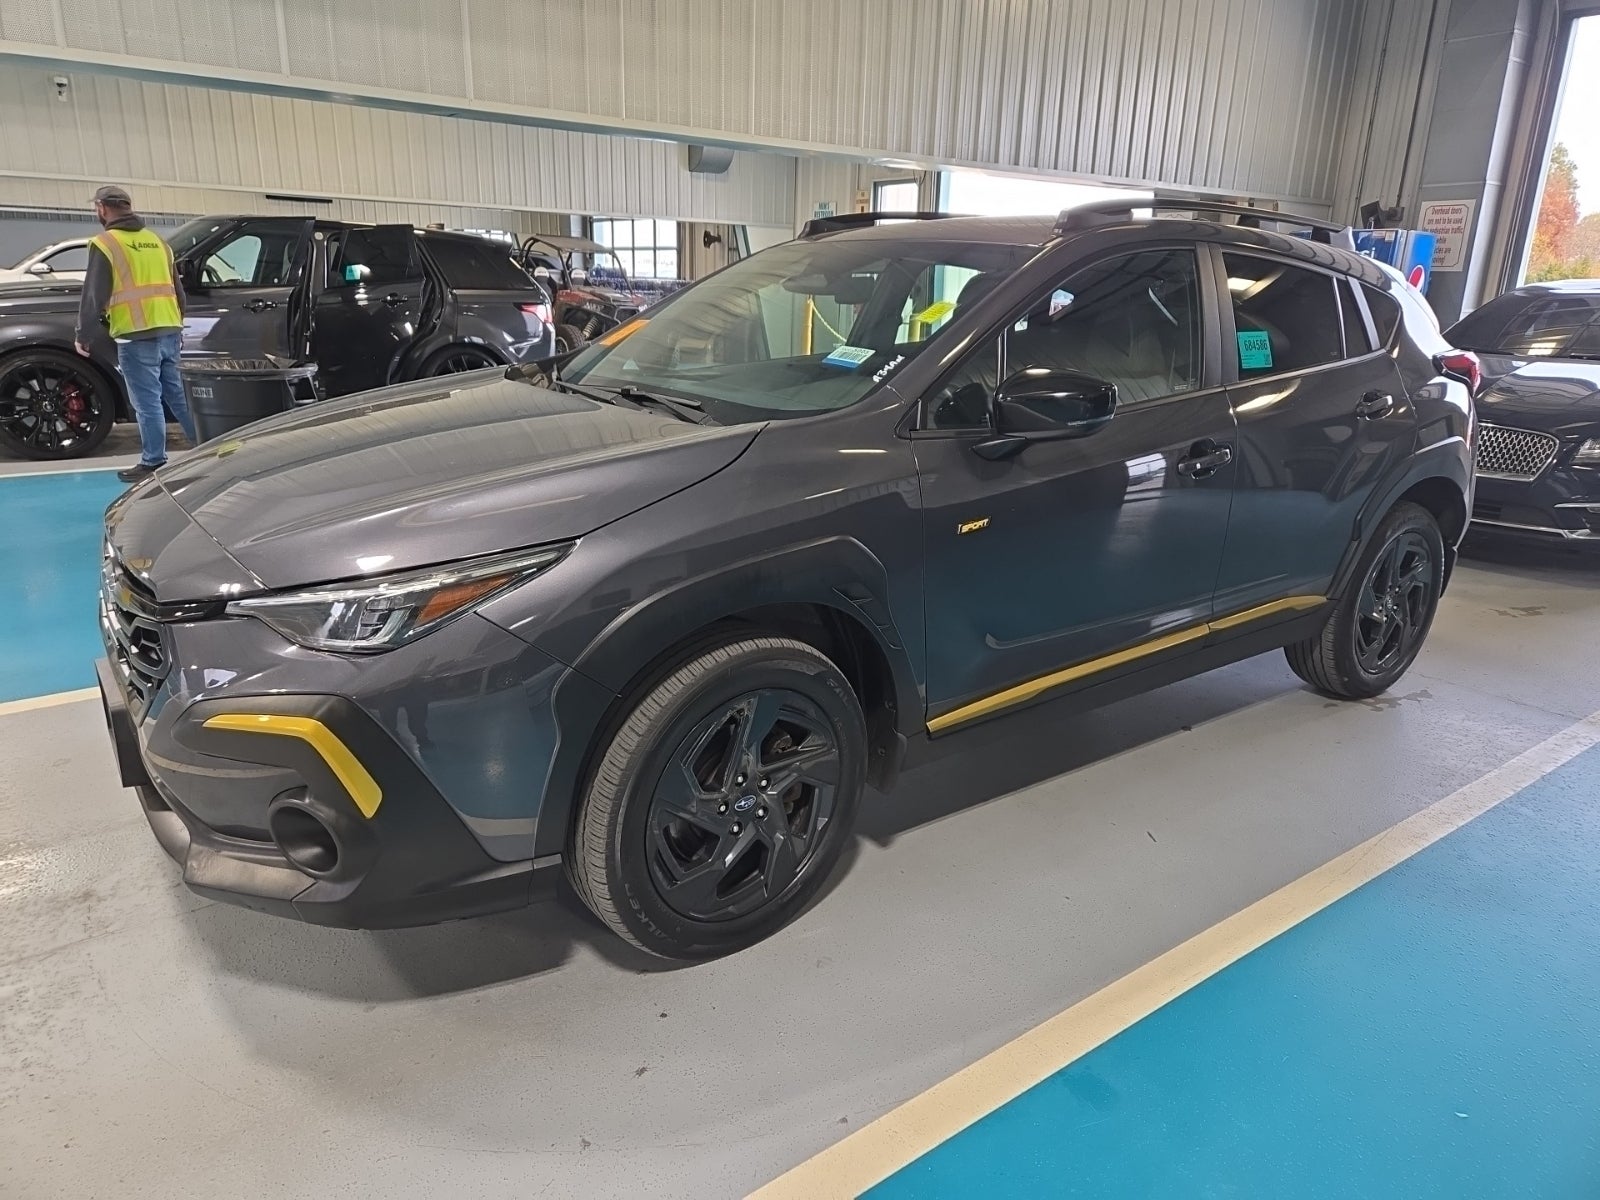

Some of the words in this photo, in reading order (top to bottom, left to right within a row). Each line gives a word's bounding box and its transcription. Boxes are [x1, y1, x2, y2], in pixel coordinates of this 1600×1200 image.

[1432, 207, 1451, 215] Overhead
[1451, 226, 1463, 234] traffic
[1243, 339, 1268, 351] 684586
[961, 518, 989, 533] SPORT
